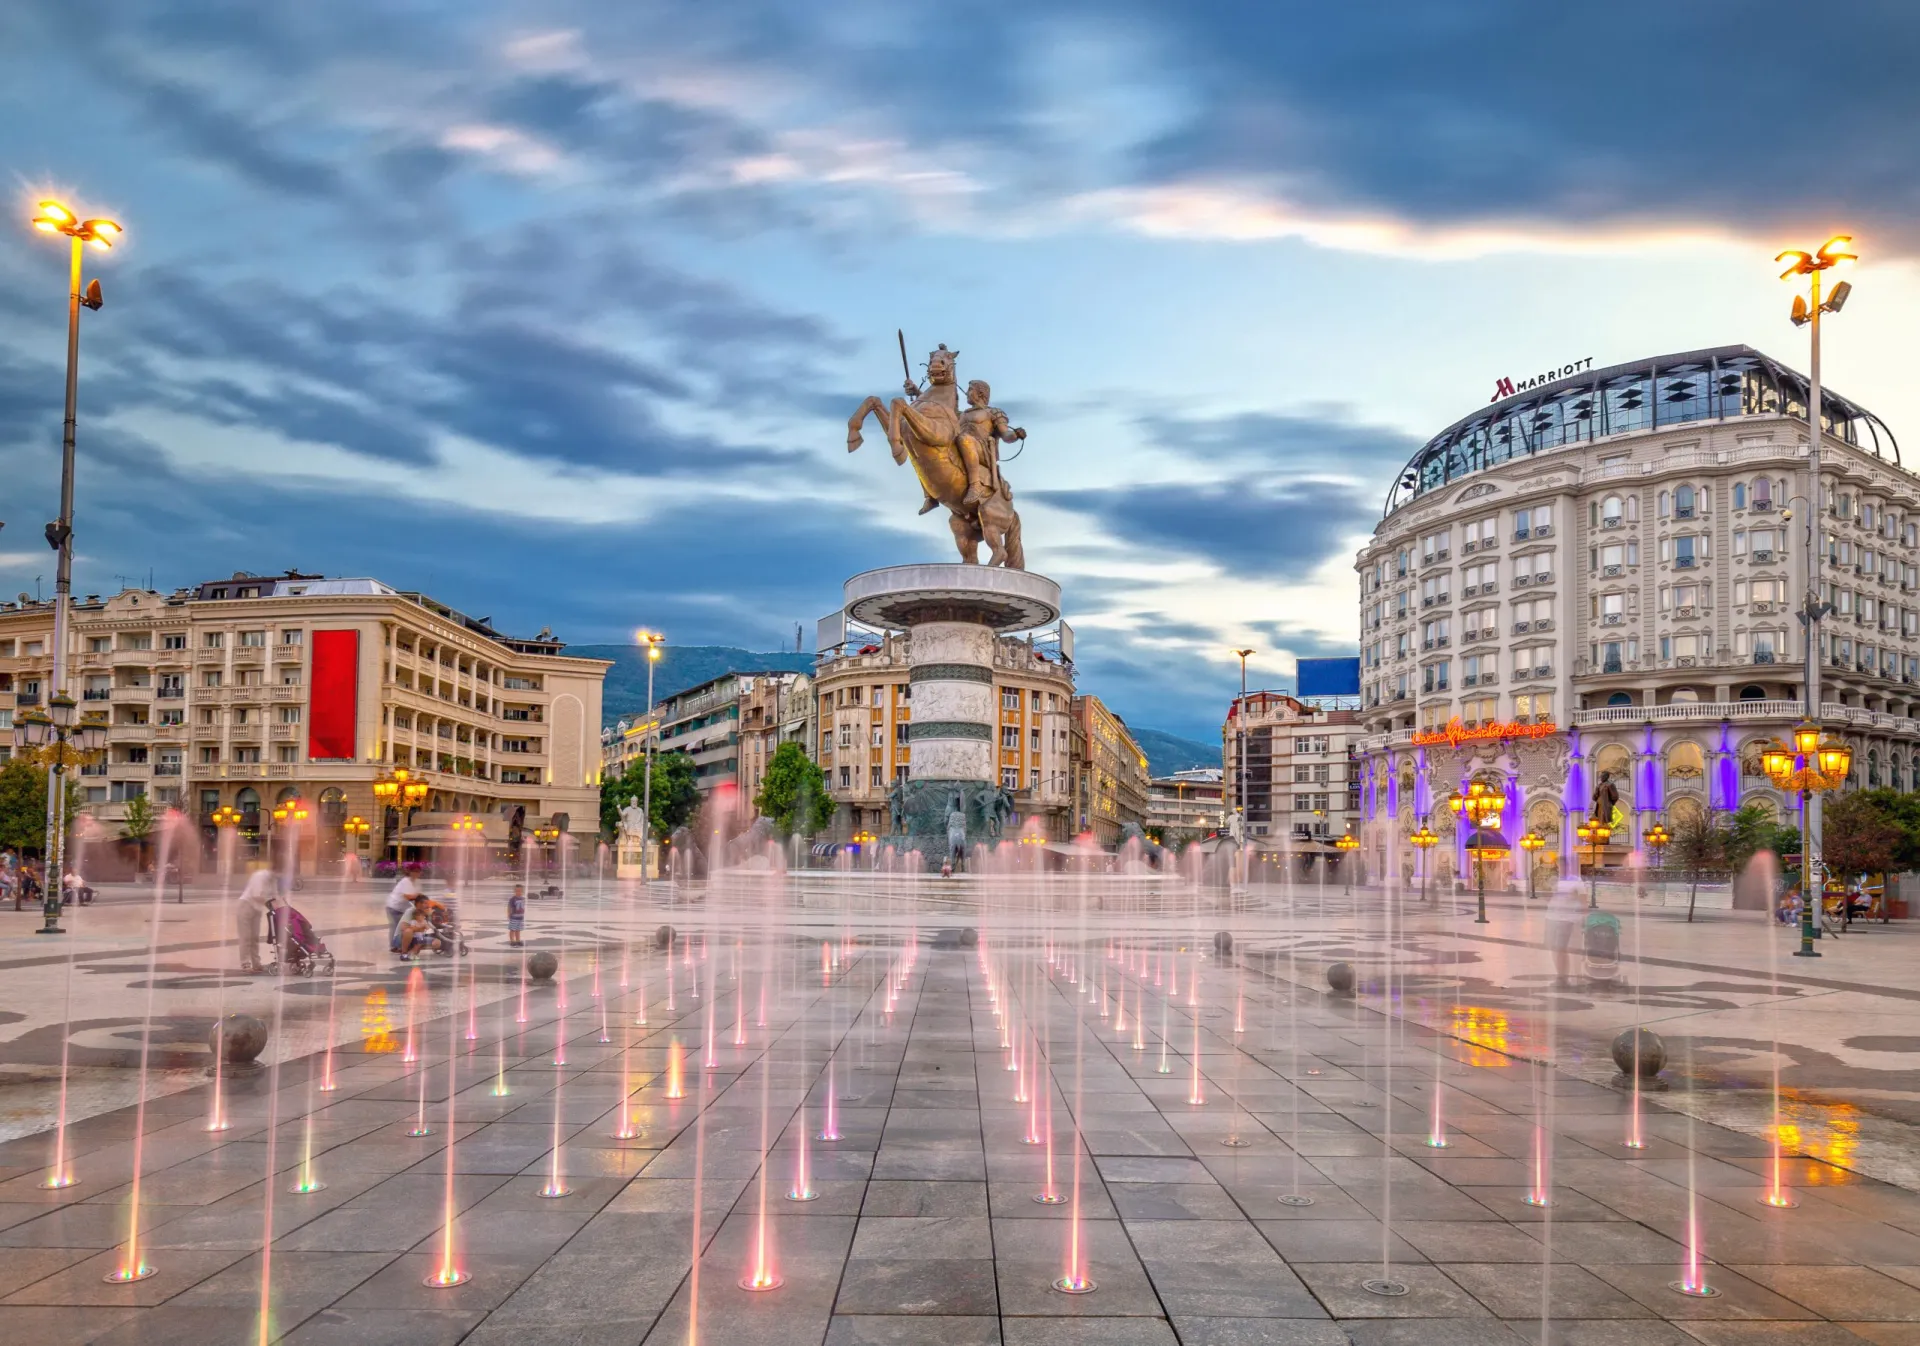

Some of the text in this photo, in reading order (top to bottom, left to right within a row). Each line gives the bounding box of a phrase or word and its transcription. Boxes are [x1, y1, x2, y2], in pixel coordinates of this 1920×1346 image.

[1517, 357, 1593, 392] MARRIOTT
[1412, 732, 1447, 745] Casino
[1505, 721, 1556, 740] Skopje
